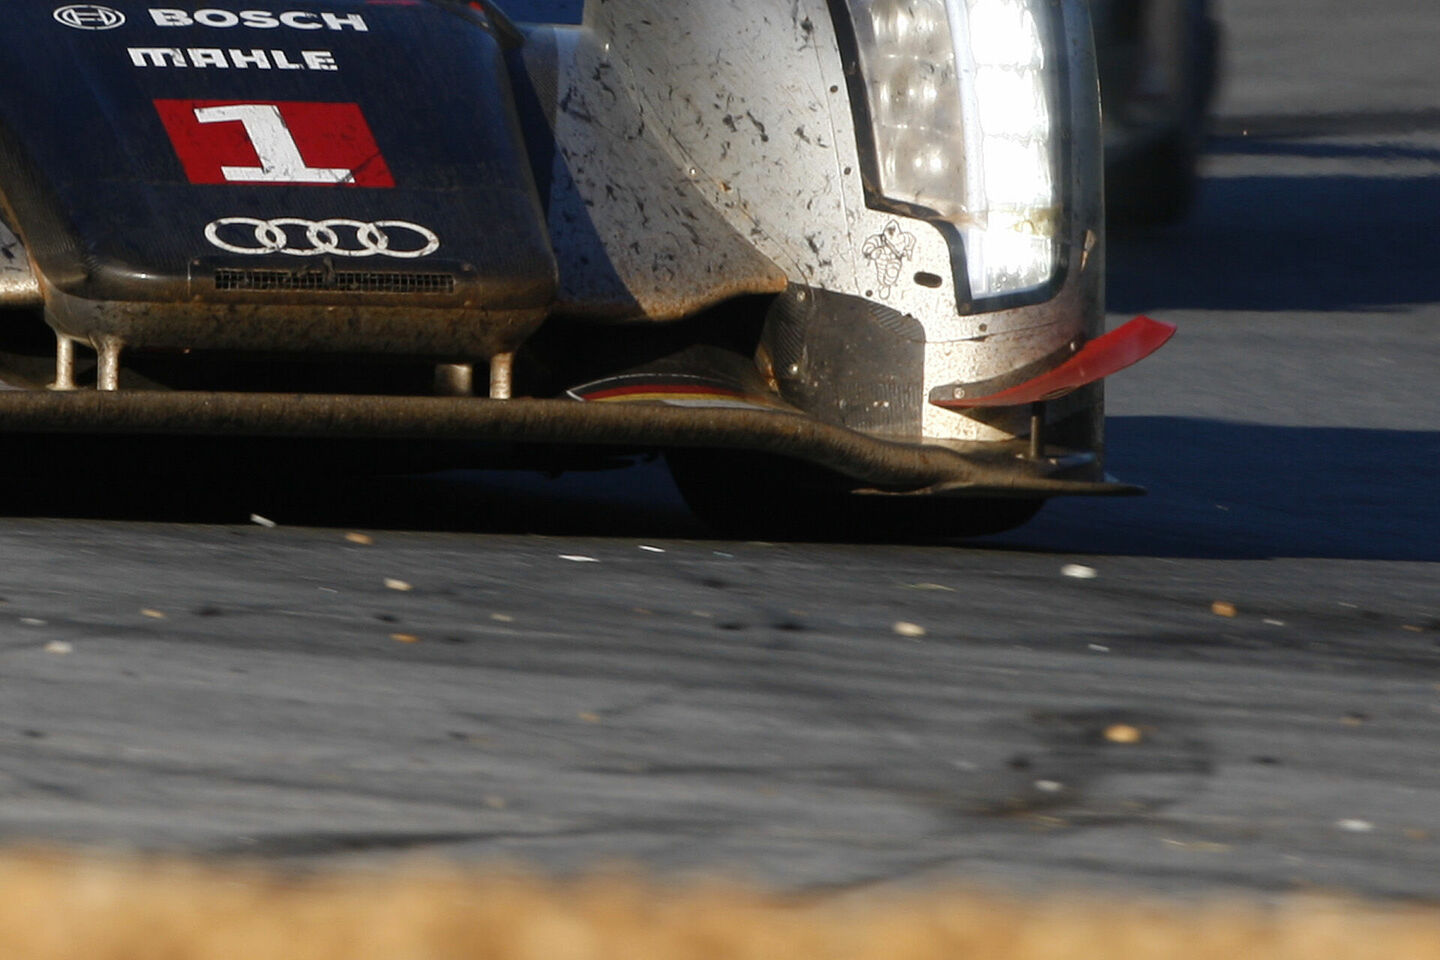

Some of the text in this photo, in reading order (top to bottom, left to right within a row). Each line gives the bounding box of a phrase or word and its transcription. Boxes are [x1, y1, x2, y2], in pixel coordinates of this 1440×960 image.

[148, 7, 369, 32] BOSCH
[126, 46, 339, 71] MAHLE
[193, 104, 356, 184] 1
